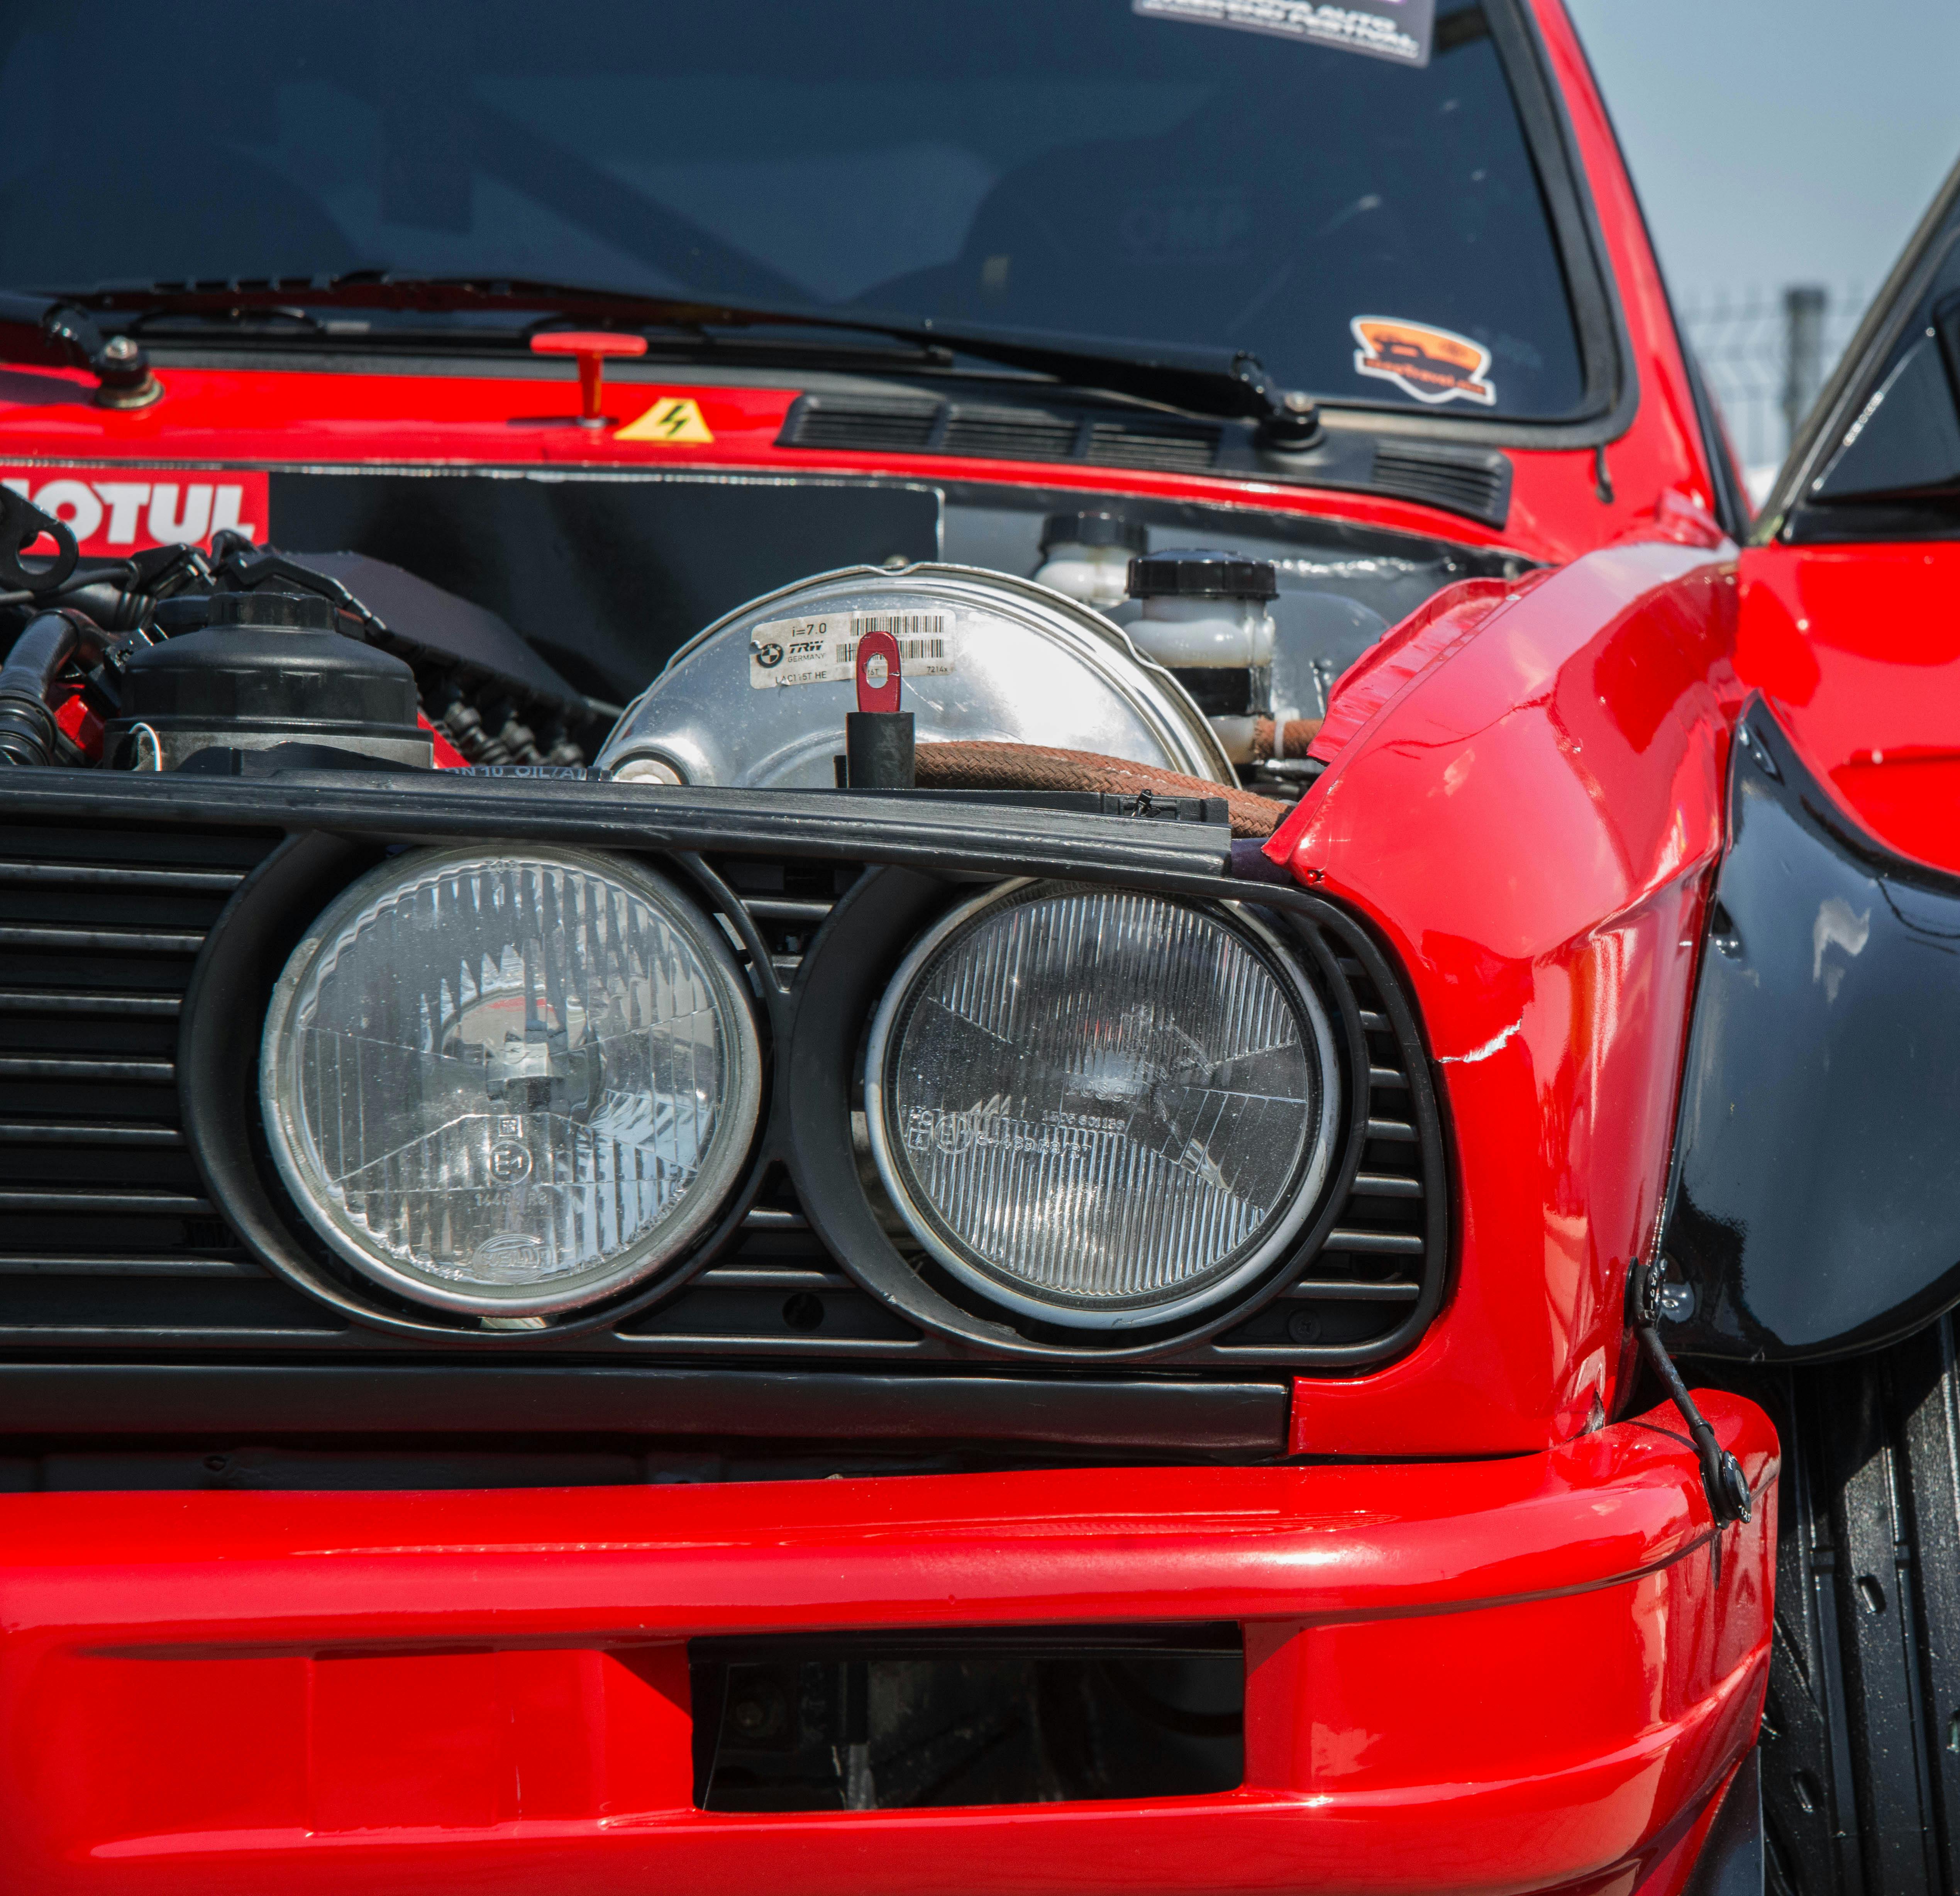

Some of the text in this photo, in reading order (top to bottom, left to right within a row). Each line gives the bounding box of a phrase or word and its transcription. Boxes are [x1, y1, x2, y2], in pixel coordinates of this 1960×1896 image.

[0, 478, 256, 546] OTUL
[792, 622, 827, 637] i=7.0
[789, 640, 823, 654] TRW
[788, 653, 825, 663] GERMANY
[1065, 1079, 1140, 1105] BOSCH
[494, 1150, 523, 1175] E1
